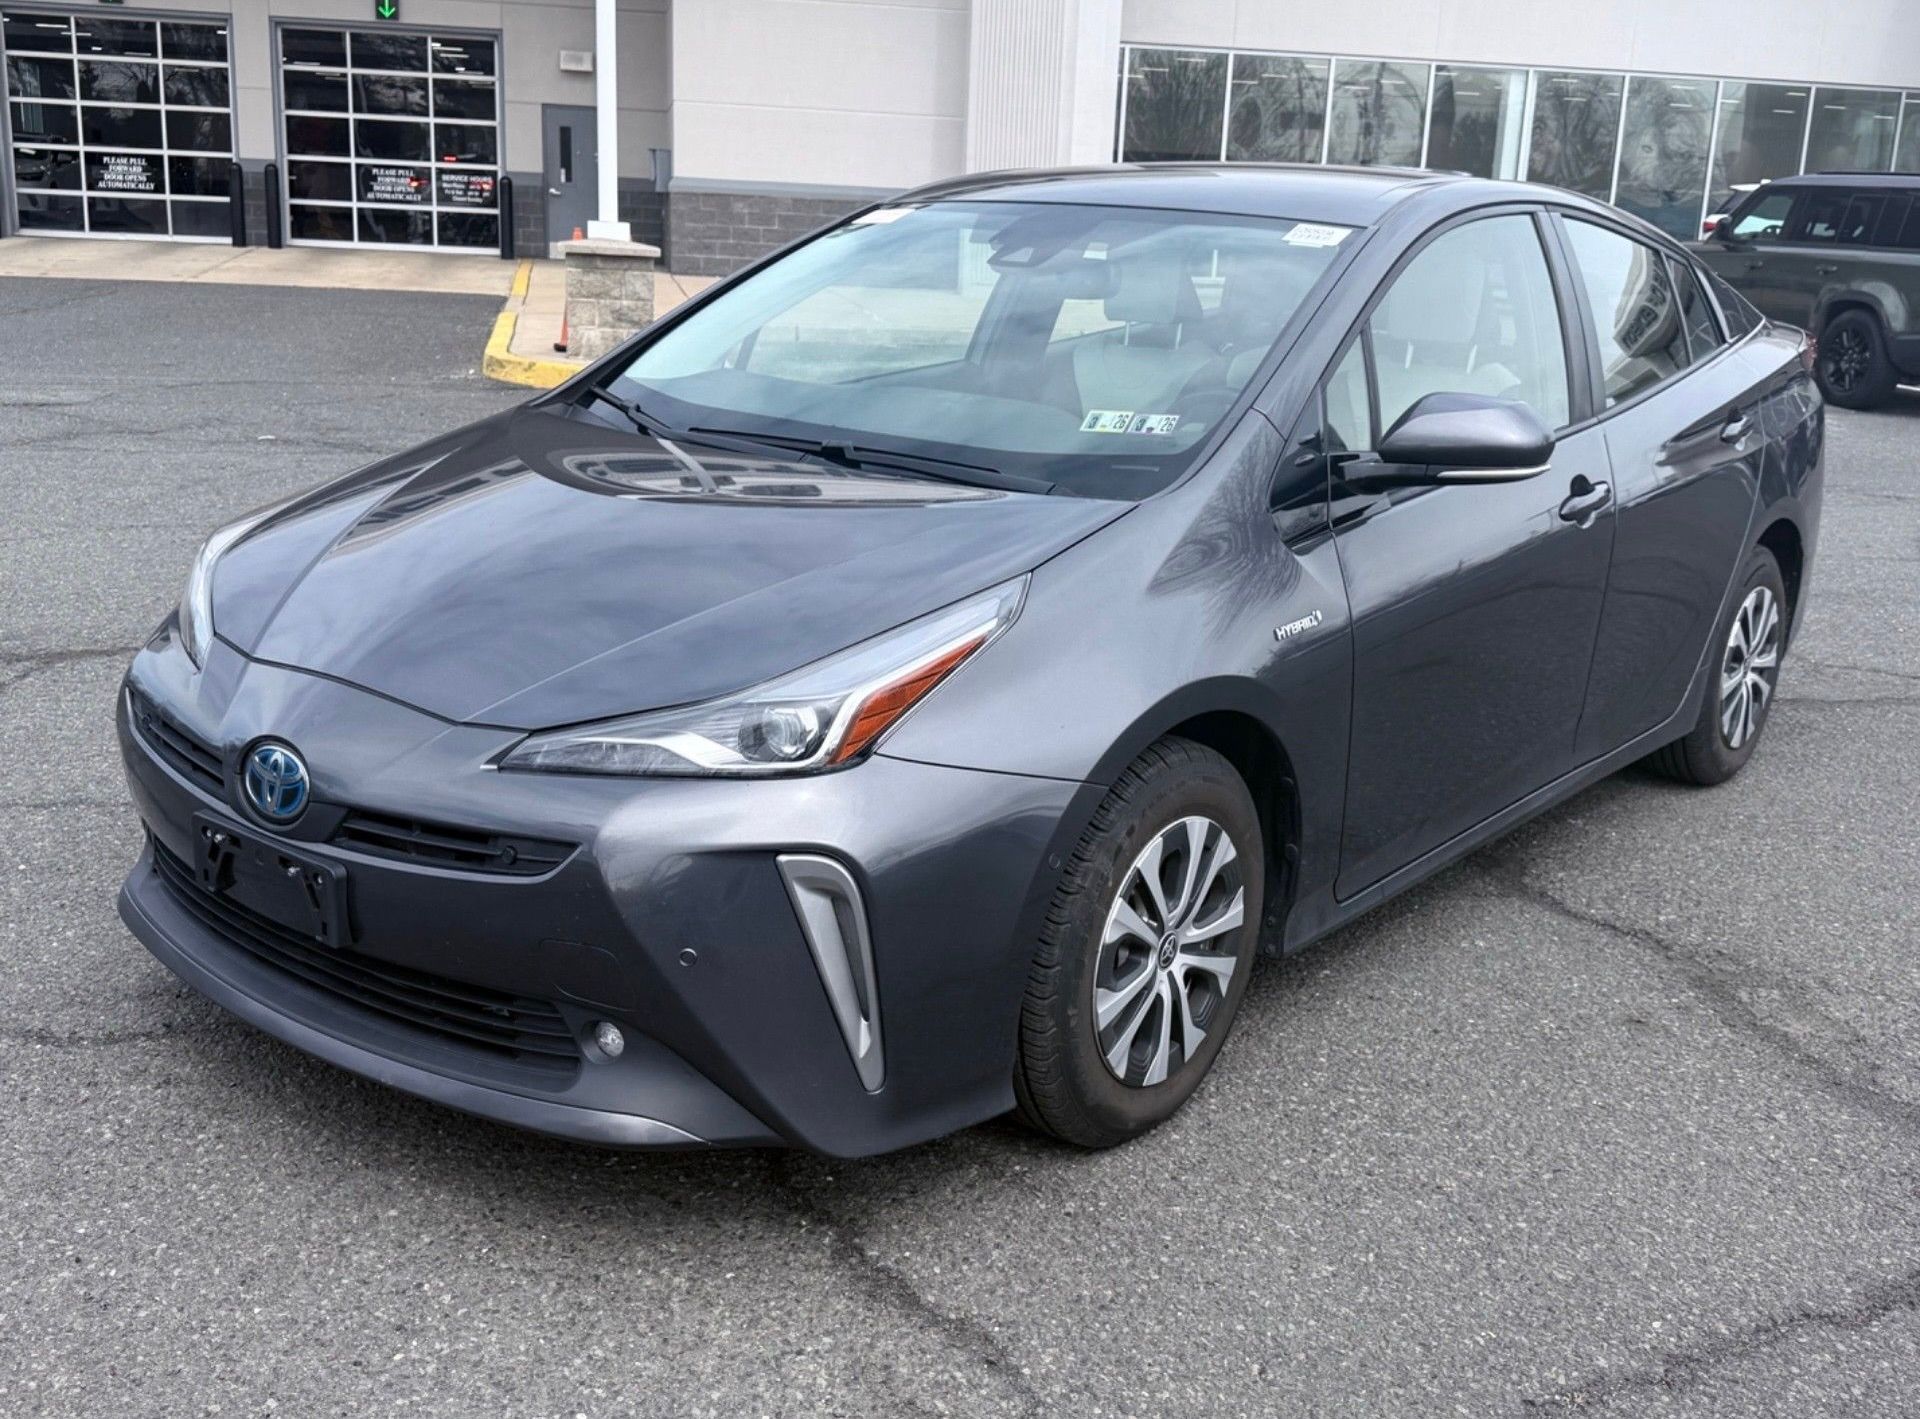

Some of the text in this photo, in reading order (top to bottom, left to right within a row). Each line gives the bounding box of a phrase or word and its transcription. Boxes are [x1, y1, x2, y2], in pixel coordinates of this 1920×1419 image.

[103, 156, 148, 166] PLEASE PULL
[108, 165, 143, 173] FORWARD
[372, 167, 415, 177] PLEASE PULL
[104, 173, 147, 182] DOOR OPENS
[97, 181, 156, 190] AUTOMATICALLY
[1112, 414, 1129, 430] 26
[1159, 416, 1177, 432] 26
[1275, 614, 1317, 640] HYBRID
